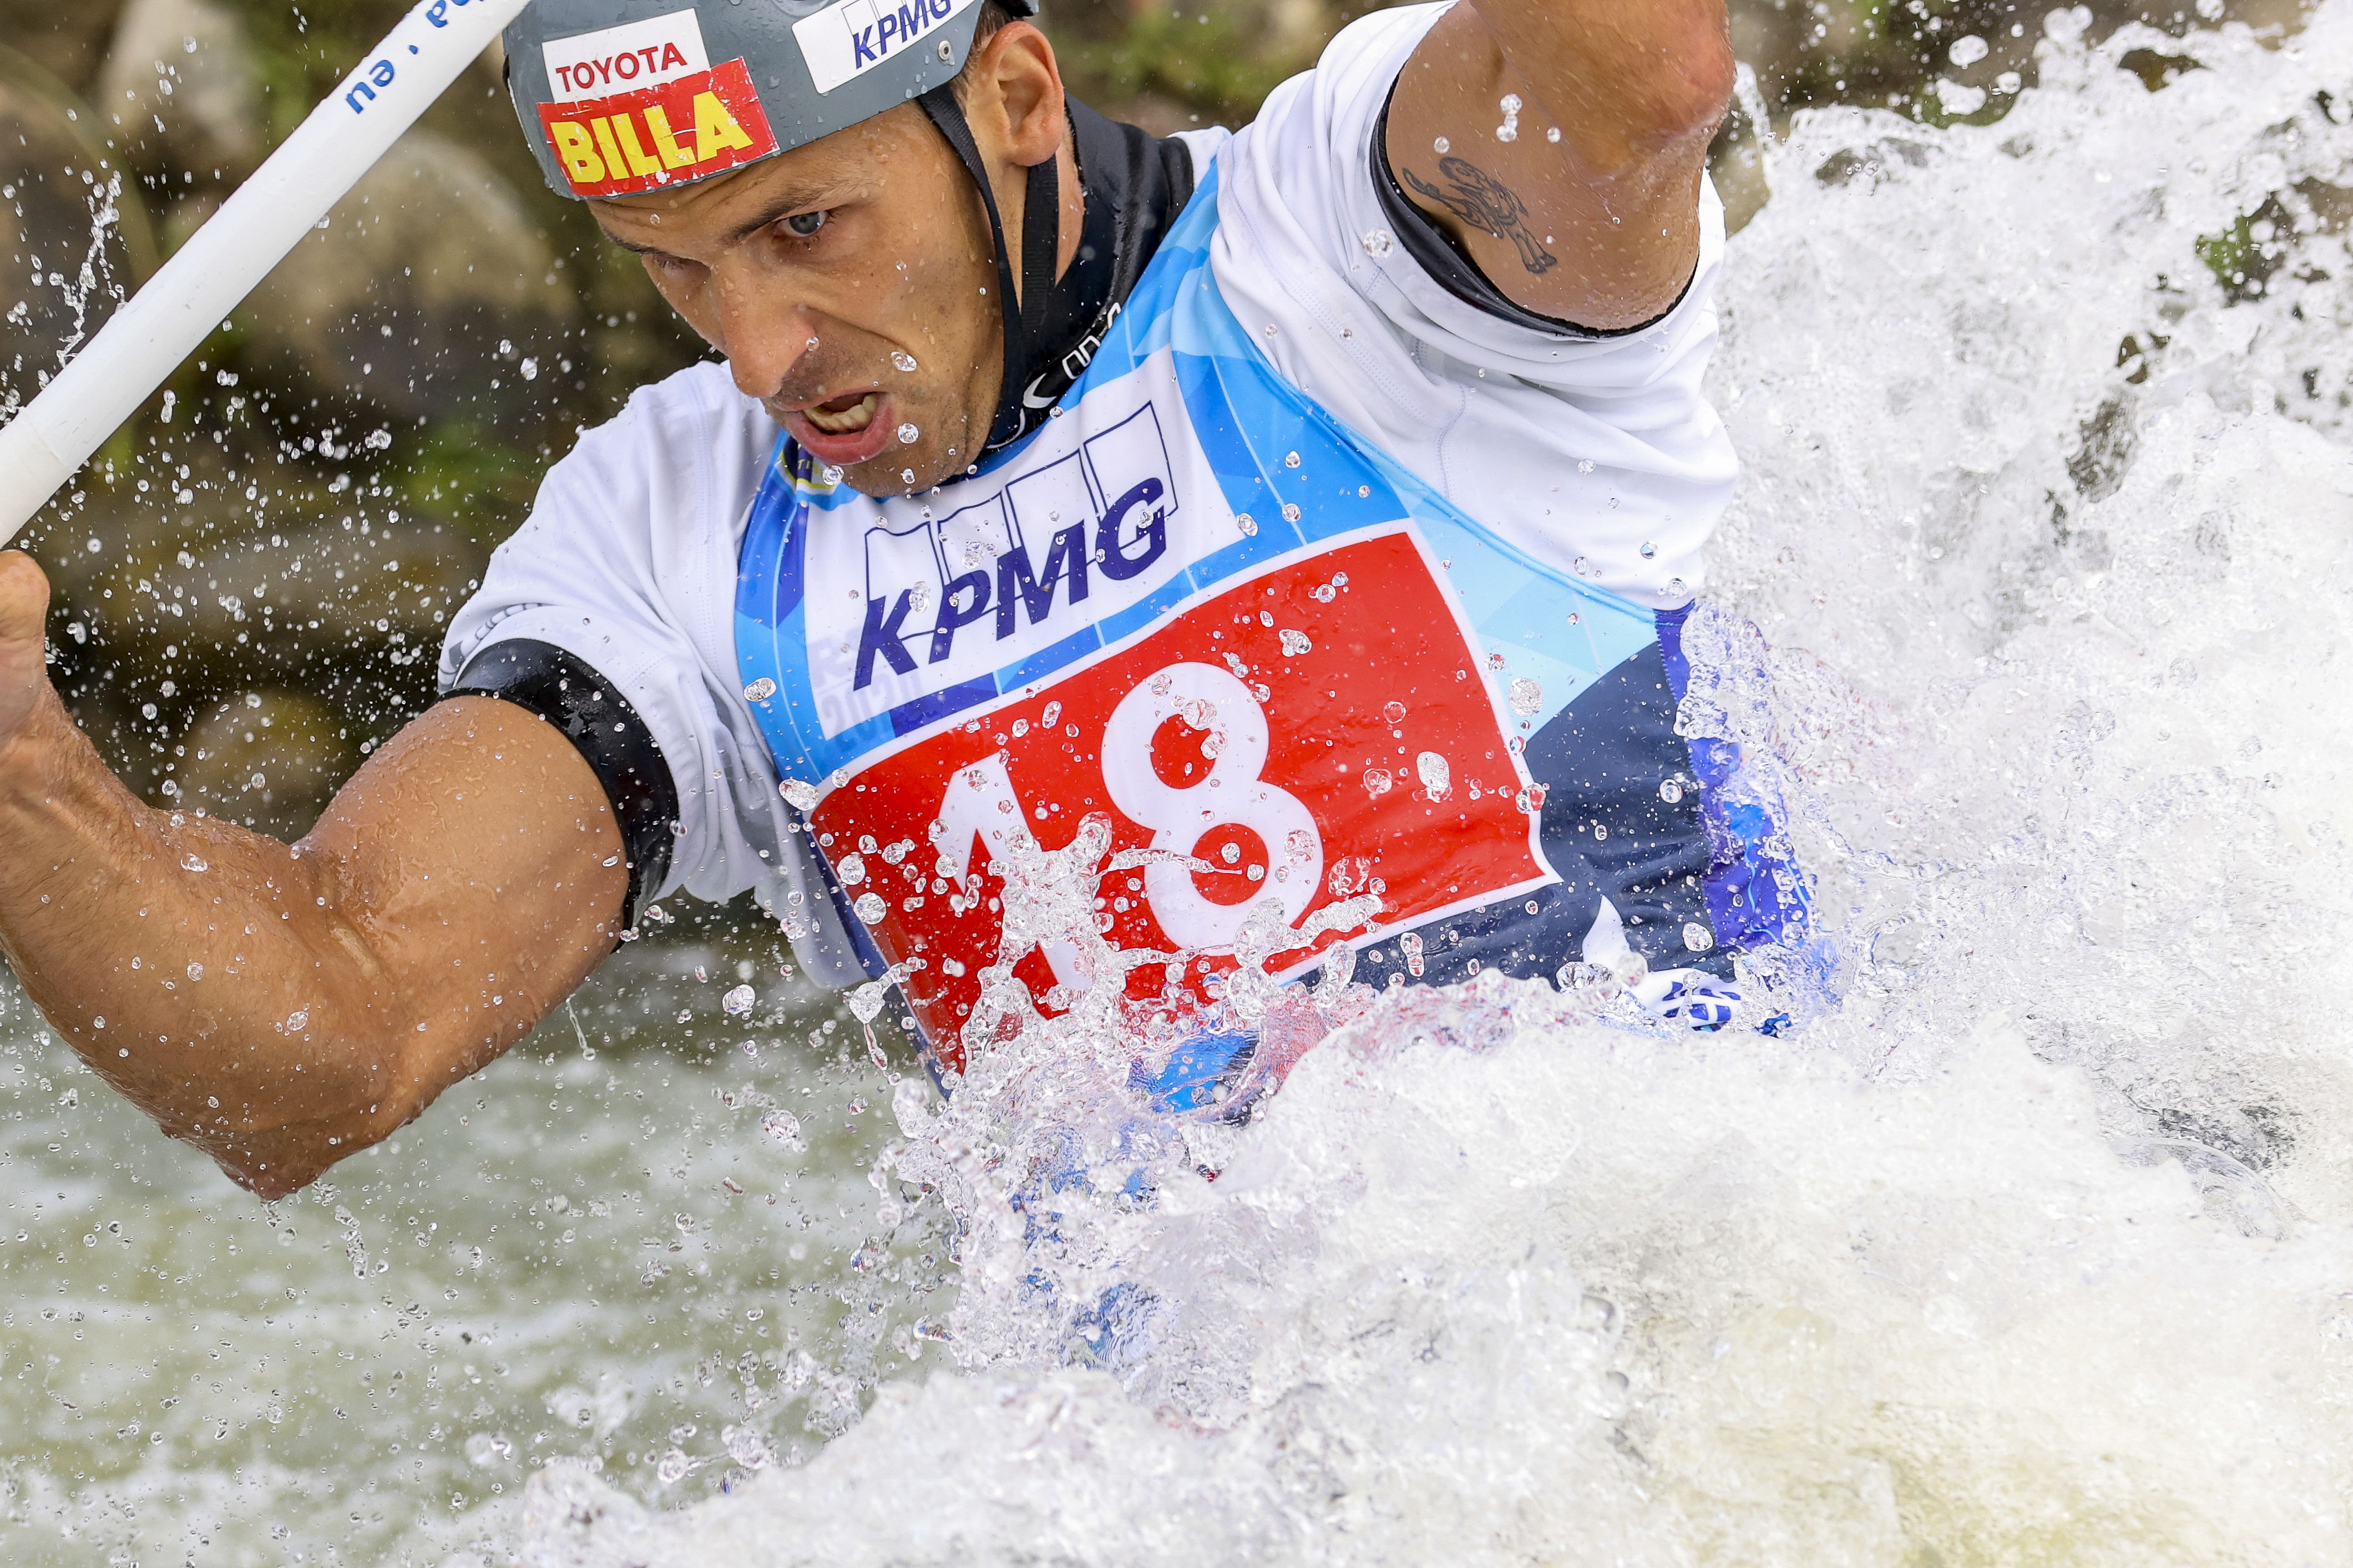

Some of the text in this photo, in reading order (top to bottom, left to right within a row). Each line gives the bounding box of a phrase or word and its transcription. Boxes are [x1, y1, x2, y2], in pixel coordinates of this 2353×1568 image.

[550, 90, 754, 184] BILLA
[555, 42, 687, 93] TOYOTA
[853, 476, 1167, 692] KPMG
[935, 662, 1324, 996] 18
